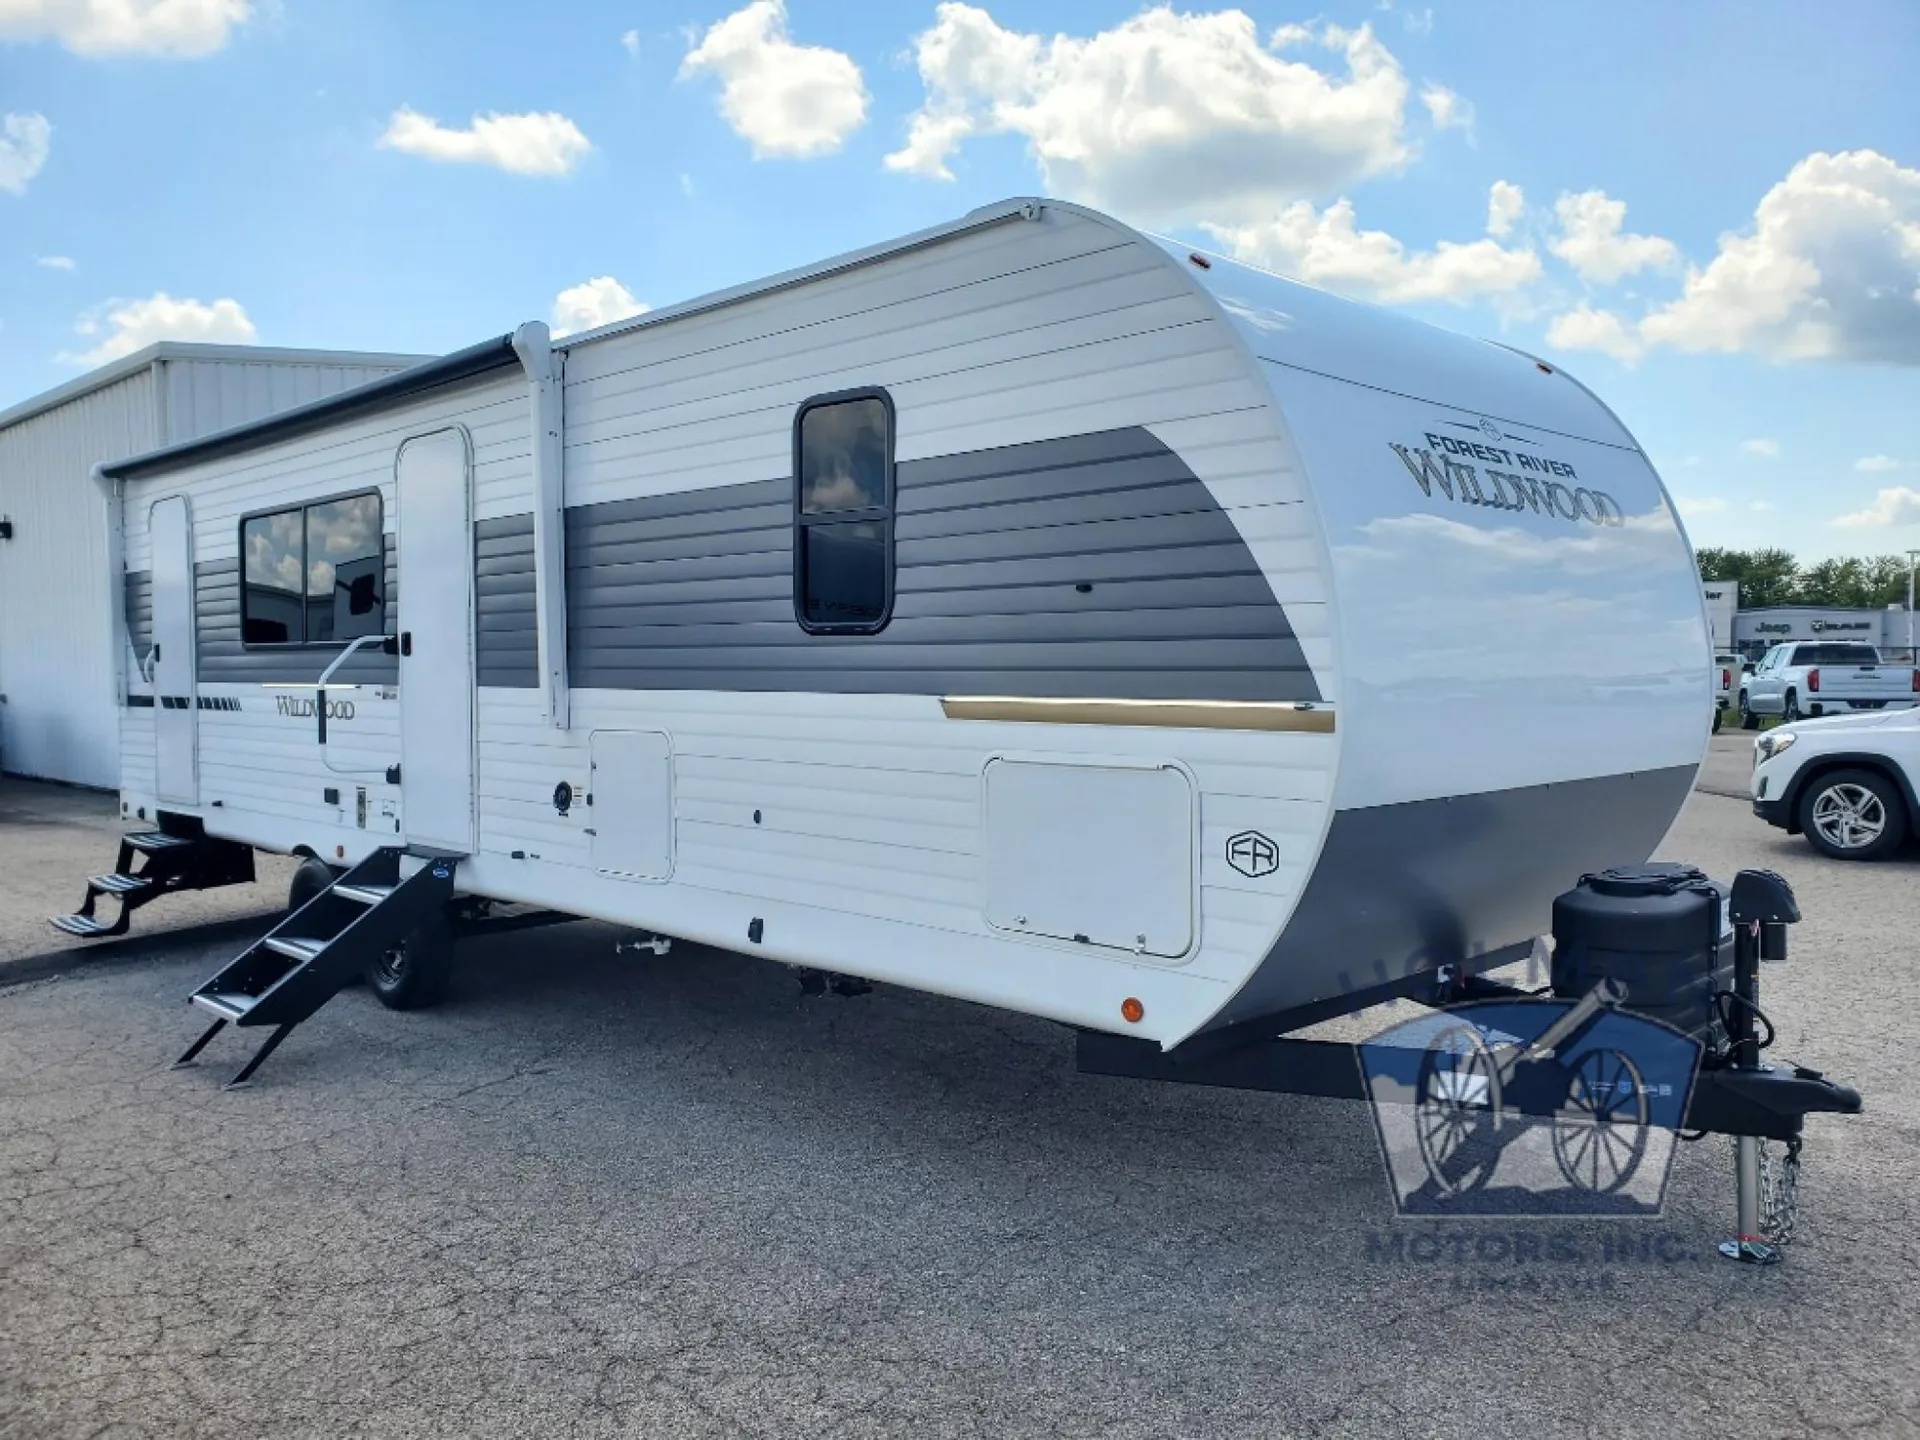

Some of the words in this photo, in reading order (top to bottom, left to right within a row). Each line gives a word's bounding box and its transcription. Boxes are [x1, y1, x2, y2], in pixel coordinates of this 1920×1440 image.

[1424, 432, 1511, 469] FOREST
[1517, 453, 1577, 479] RIVER
[1388, 441, 1625, 528] WILDWOOD
[1754, 621, 1792, 635] Jeep
